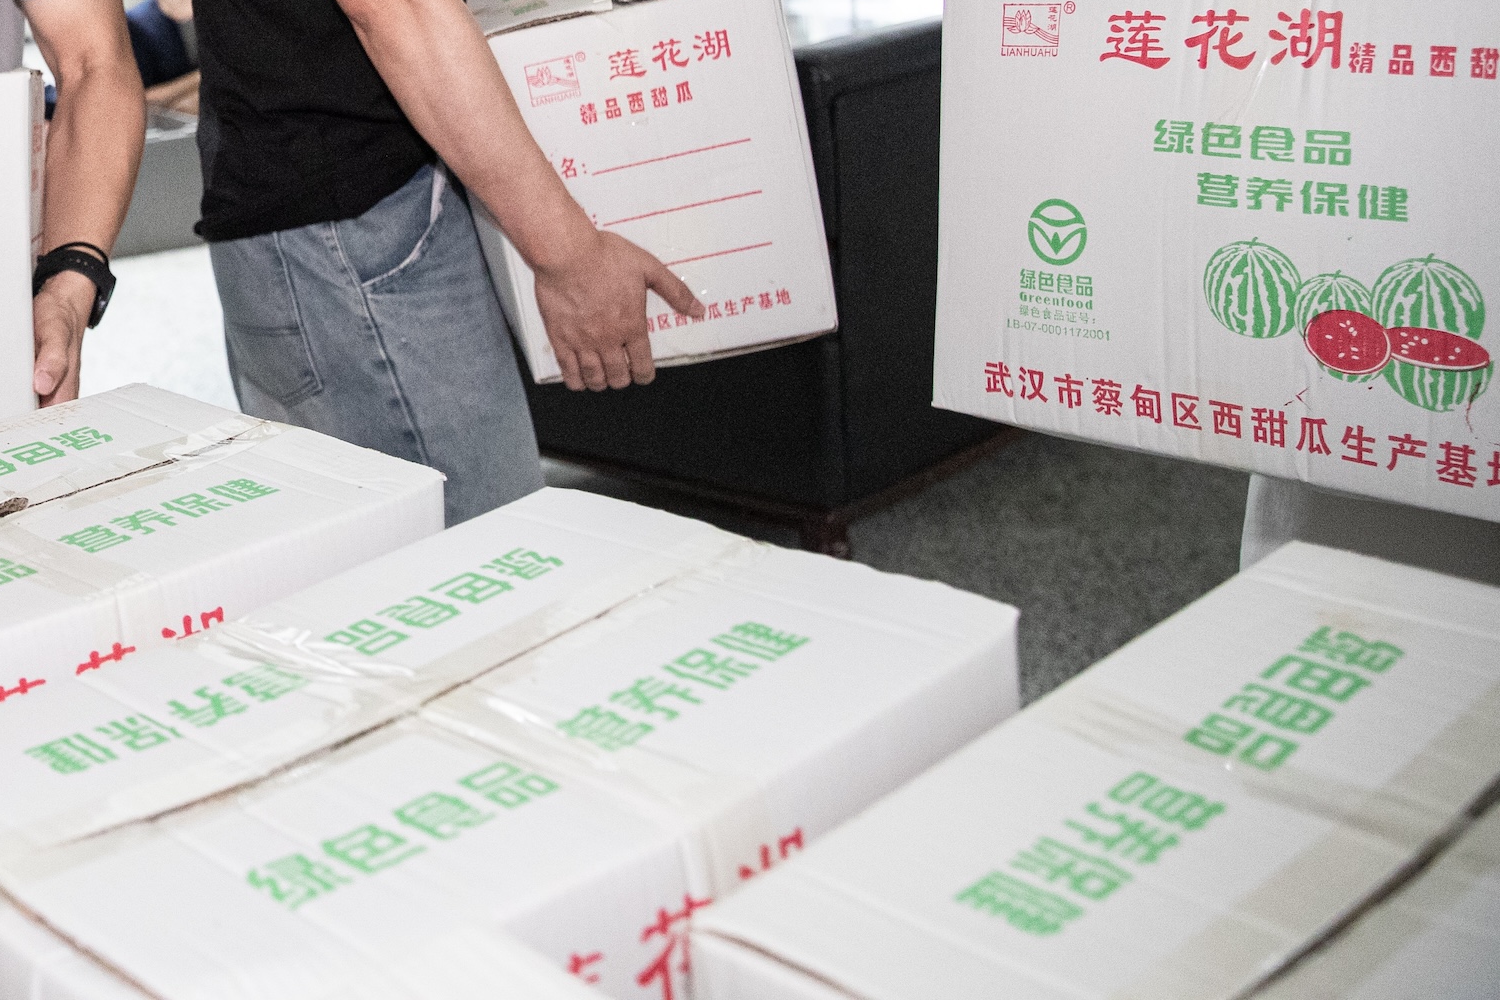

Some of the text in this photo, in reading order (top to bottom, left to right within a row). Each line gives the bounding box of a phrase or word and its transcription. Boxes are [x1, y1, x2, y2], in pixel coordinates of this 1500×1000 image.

[608, 28, 732, 80] 莲花湖
[1001, 48, 1058, 57] LIANHUAHU
[1099, 8, 1500, 80] 莲花湖 精品西甜
[579, 80, 693, 125] 精品西甜瓜
[1153, 119, 1352, 167] 绿色食品
[1197, 172, 1409, 223] 营养保健
[1019, 268, 1094, 297] 绿色食品
[1019, 291, 1093, 310] Greenfood
[58, 478, 279, 554] 营养保健
[24, 547, 565, 775] 绿色食品 营养保健
[1182, 625, 1406, 772] 绿色食品
[246, 621, 811, 910] 绿色食品 营养保健
[953, 771, 1227, 937] 营养保健
